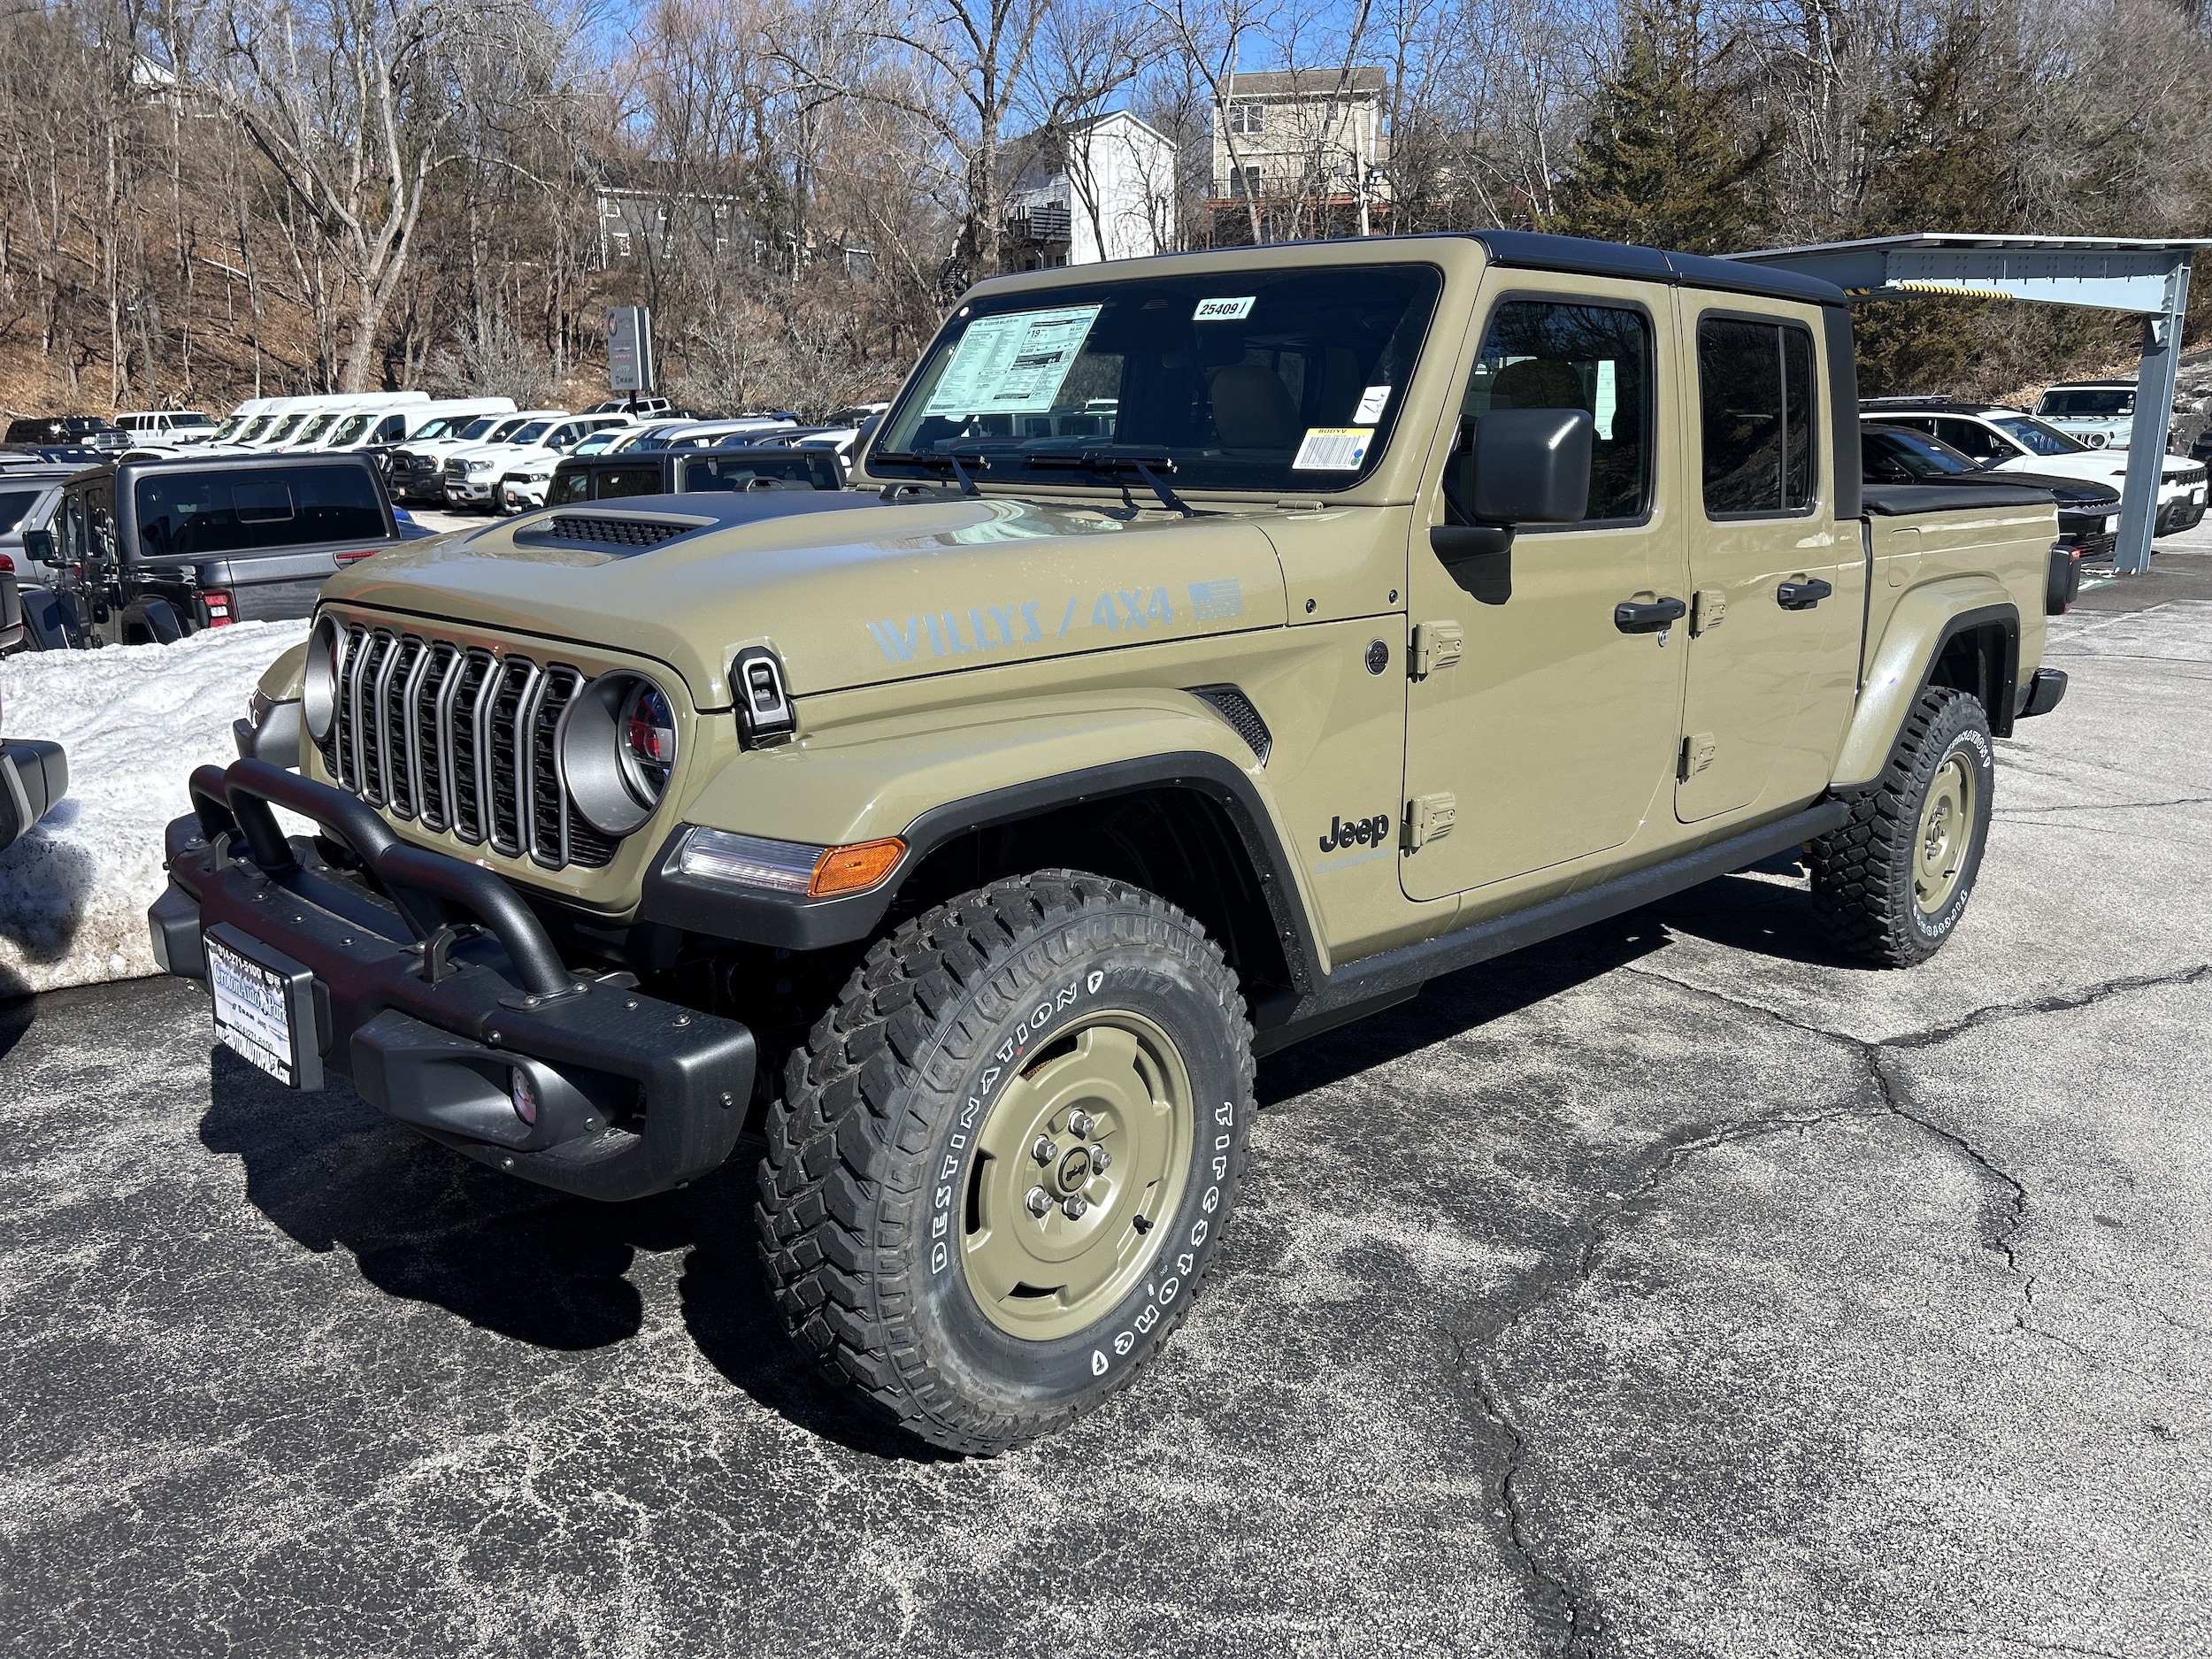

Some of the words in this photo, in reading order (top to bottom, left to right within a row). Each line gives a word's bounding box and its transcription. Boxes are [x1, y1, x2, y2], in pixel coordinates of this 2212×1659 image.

[1199, 303, 1239, 316] 25409
[1031, 328, 1041, 338] 19
[866, 601, 1042, 663] WILLYS
[1090, 586, 1175, 633] 4X4
[1319, 814, 1389, 853] Jeep
[217, 944, 263, 980] 914-271-5100
[931, 981, 1079, 1276] DESTINATION
